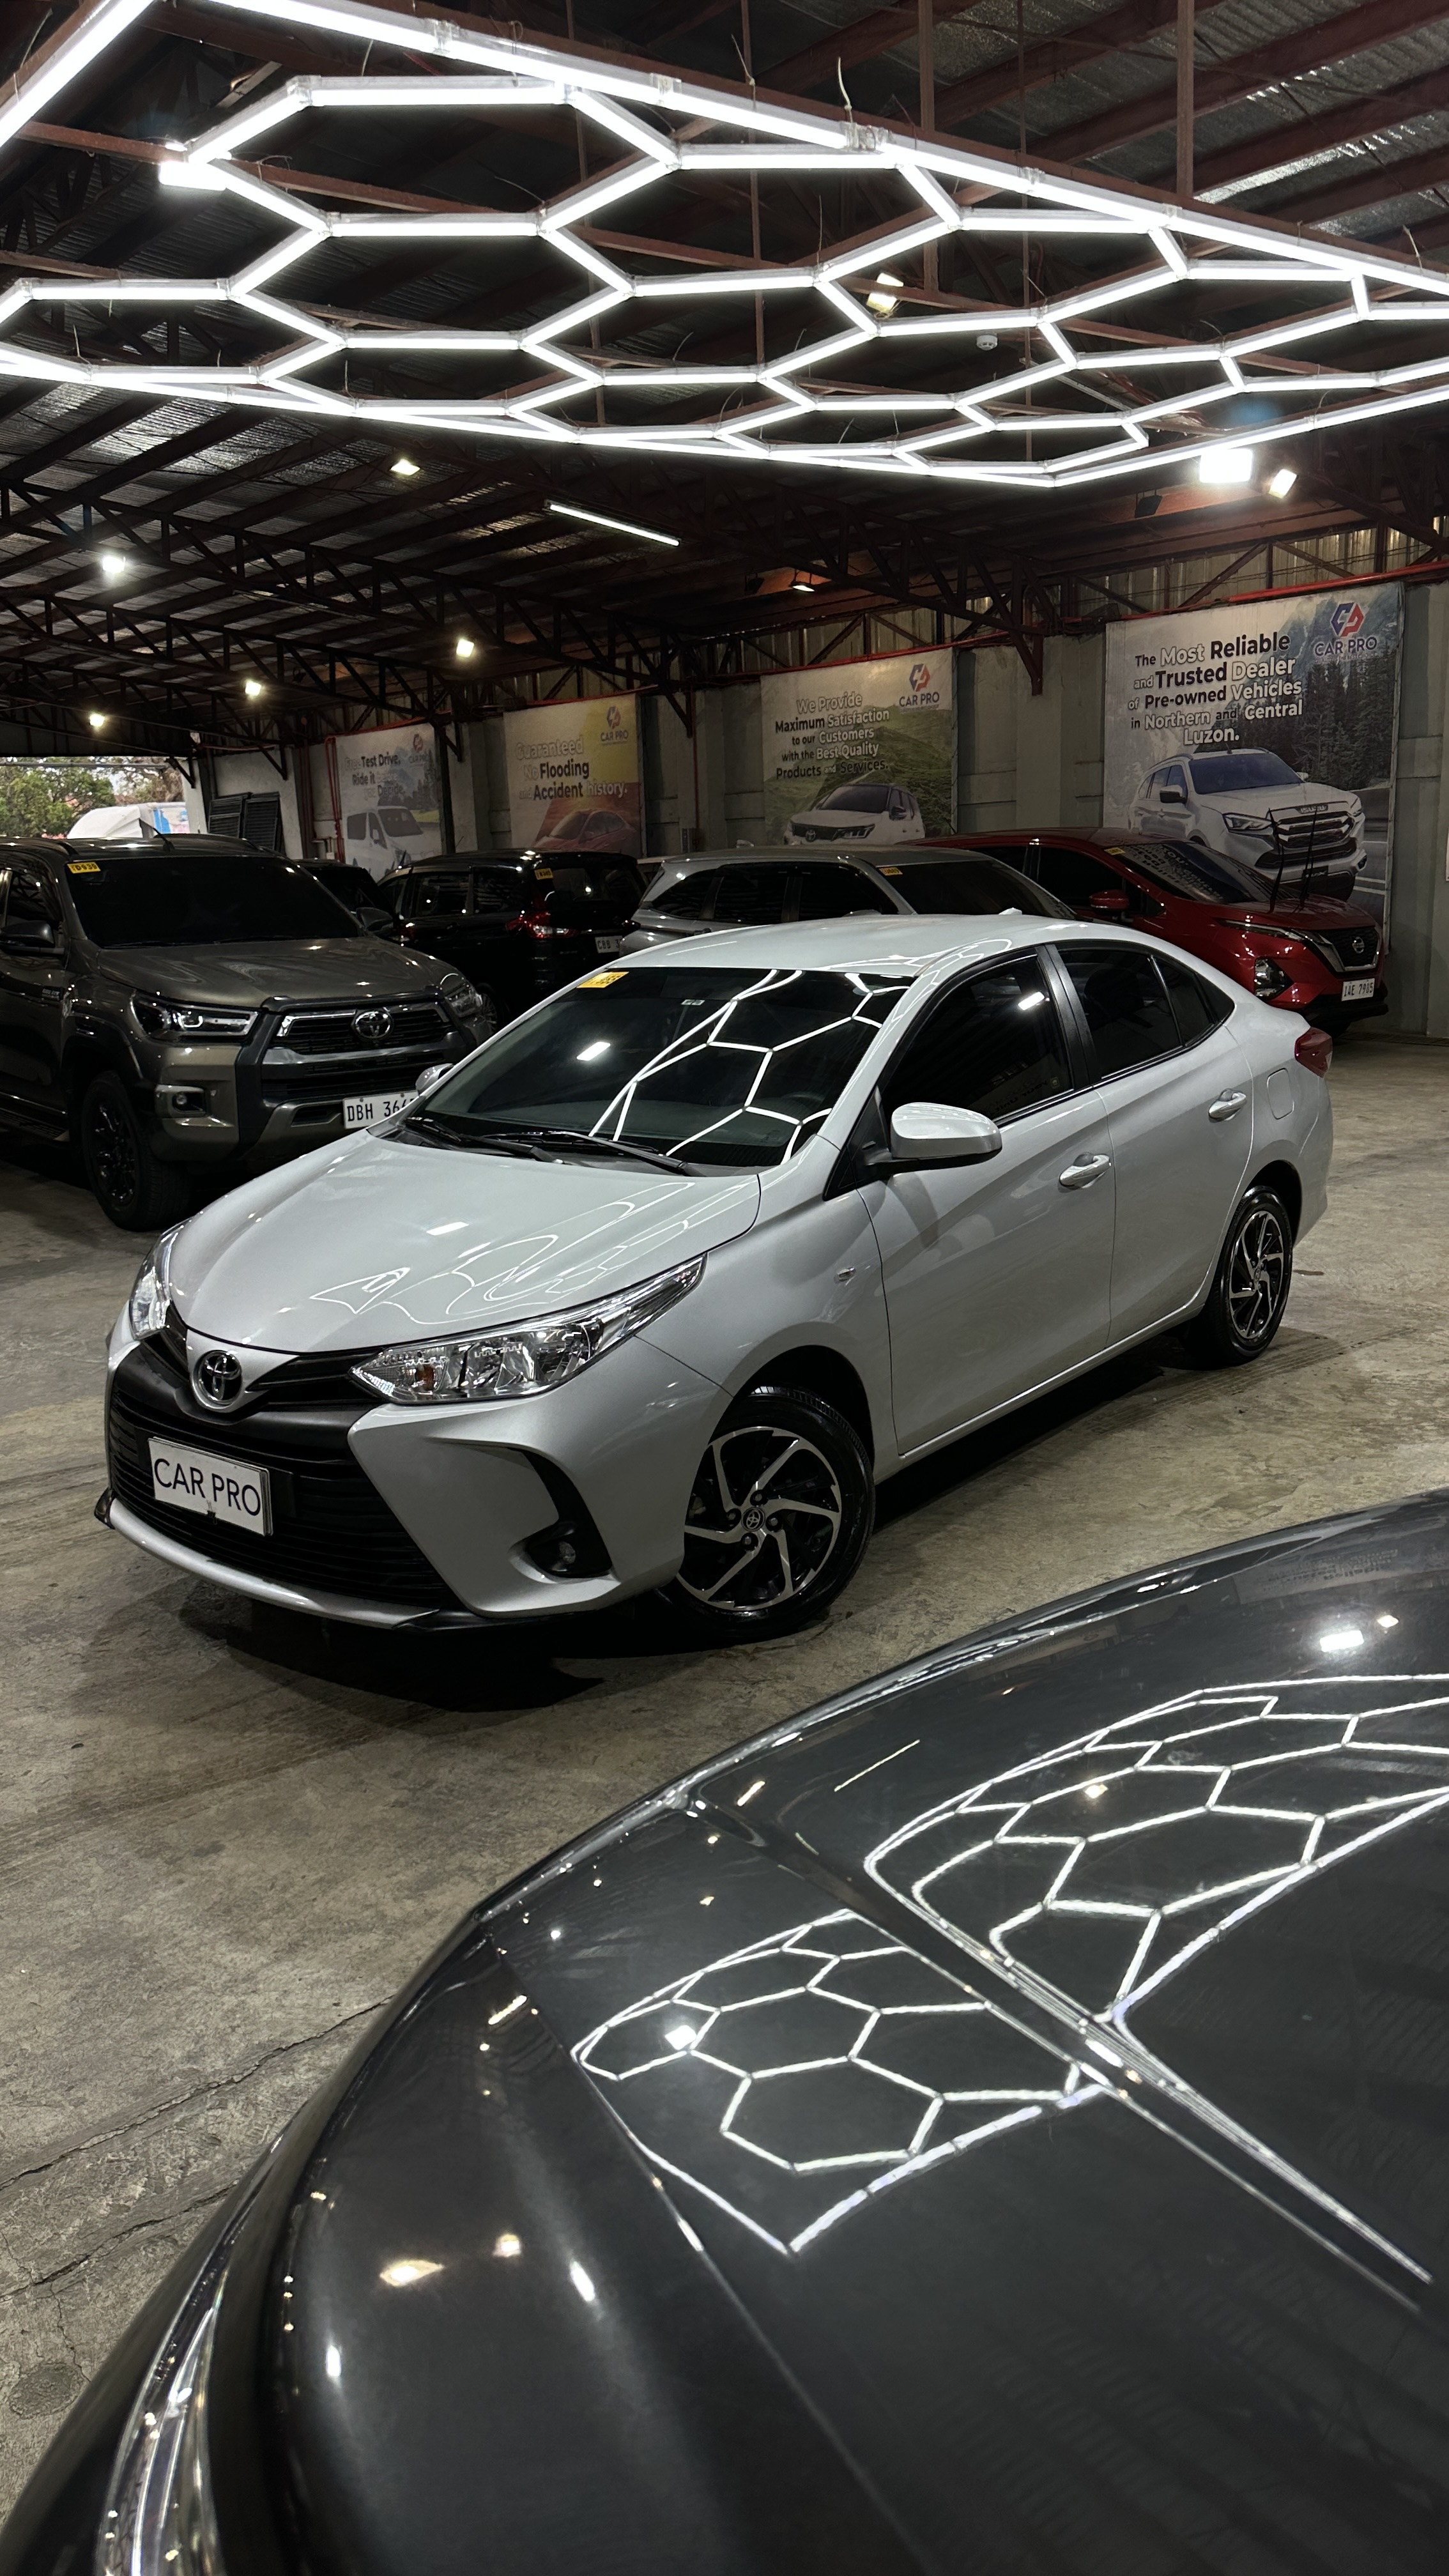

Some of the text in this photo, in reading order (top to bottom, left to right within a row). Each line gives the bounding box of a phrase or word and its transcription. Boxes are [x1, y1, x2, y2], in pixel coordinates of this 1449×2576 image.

[1135, 631, 1291, 667] The Most Reliable
[1315, 636, 1377, 656] CAR PRO
[1134, 656, 1296, 689] and Trusted Dealer
[797, 691, 862, 714] We Provide
[899, 691, 940, 707] CAR PRO
[1128, 679, 1302, 710] of Pre-owned Vehicles
[776, 708, 890, 733] Maximum Satisfaction
[1131, 699, 1303, 730] in Northern and Central
[601, 730, 629, 742] CAR PRO
[792, 727, 875, 746] to our Customers
[1183, 727, 1240, 746] Luzon.
[361, 755, 378, 767] Test
[378, 751, 401, 765] Drive,
[516, 737, 584, 761] Guaranteed
[781, 740, 880, 762] with the Best Quality
[352, 772, 369, 786] Ride
[369, 771, 376, 785] it
[524, 758, 590, 781] No Flooding
[776, 758, 889, 779] Products and Services.
[533, 781, 583, 800] Accident
[586, 779, 628, 799] history.
[346, 1103, 374, 1122] DBH
[154, 1458, 261, 1516] CAR PRO
